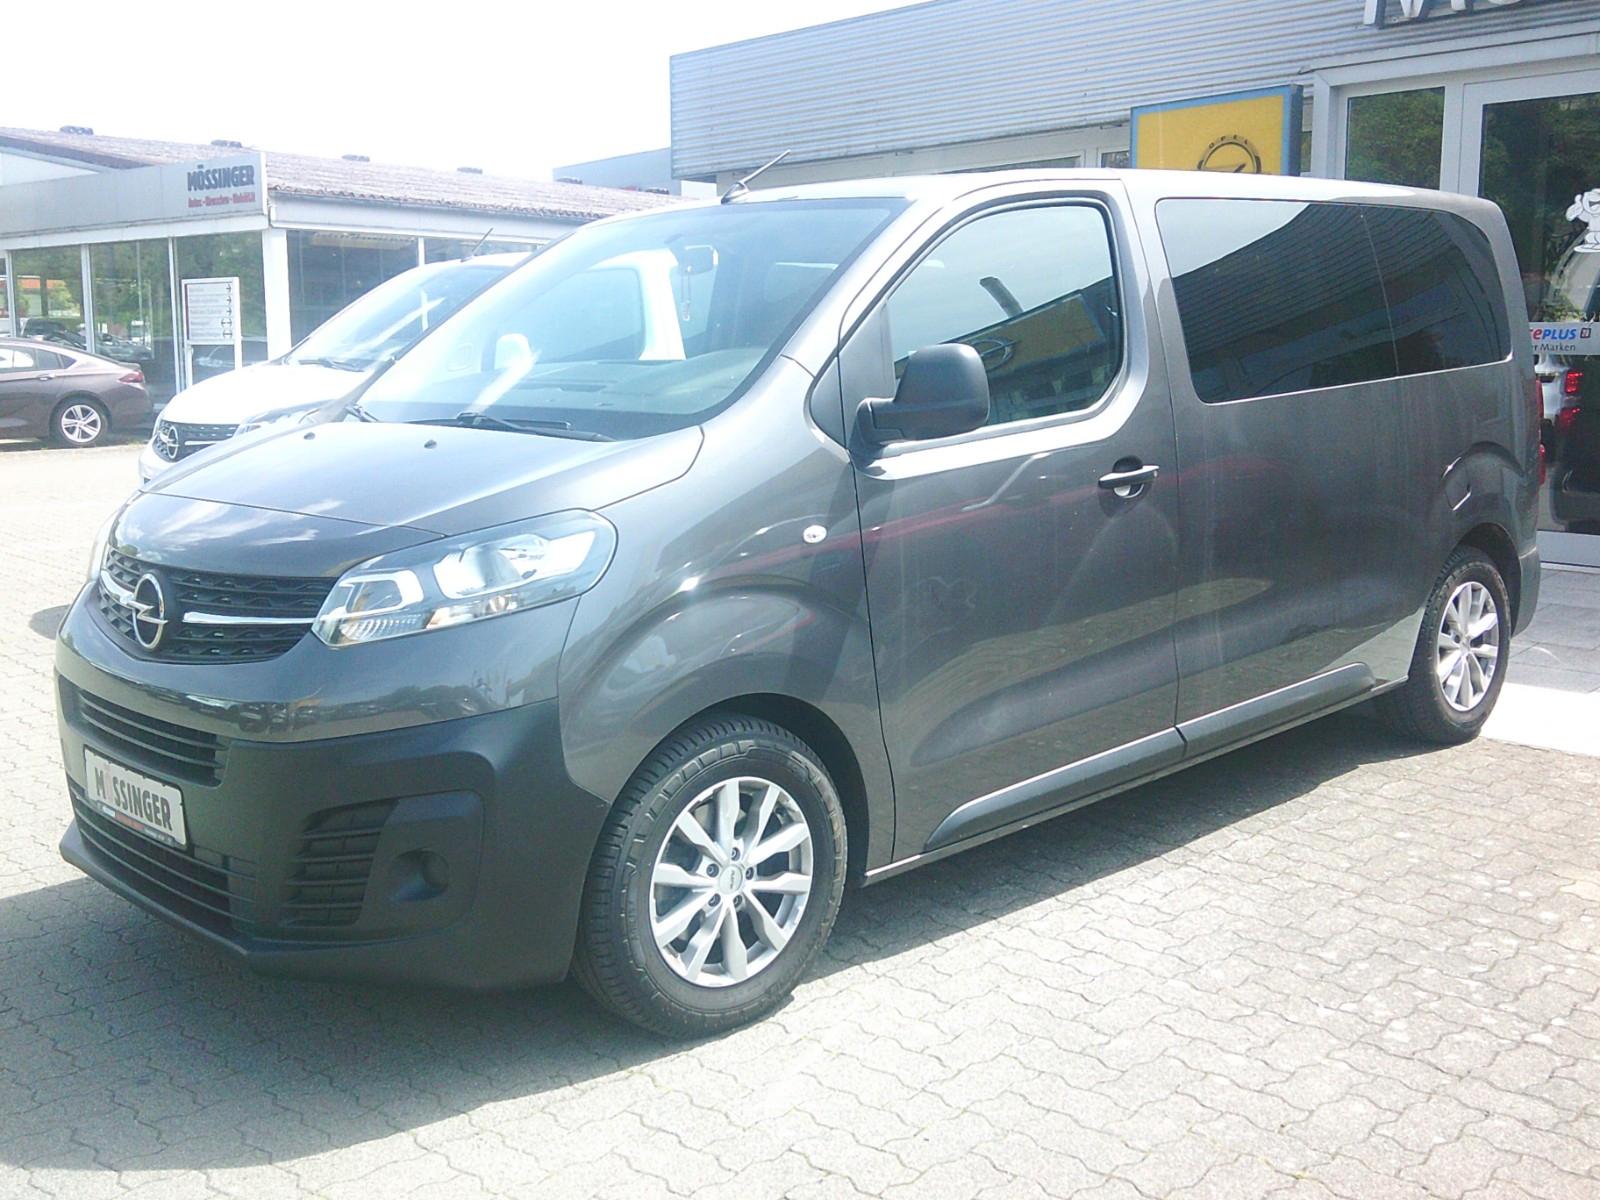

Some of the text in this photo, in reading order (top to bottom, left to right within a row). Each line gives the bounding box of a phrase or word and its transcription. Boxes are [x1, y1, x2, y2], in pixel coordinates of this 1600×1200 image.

[1530, 327, 1577, 340] ePLUS
[1540, 343, 1576, 351] Marken
[94, 766, 173, 831] MSSINGER
